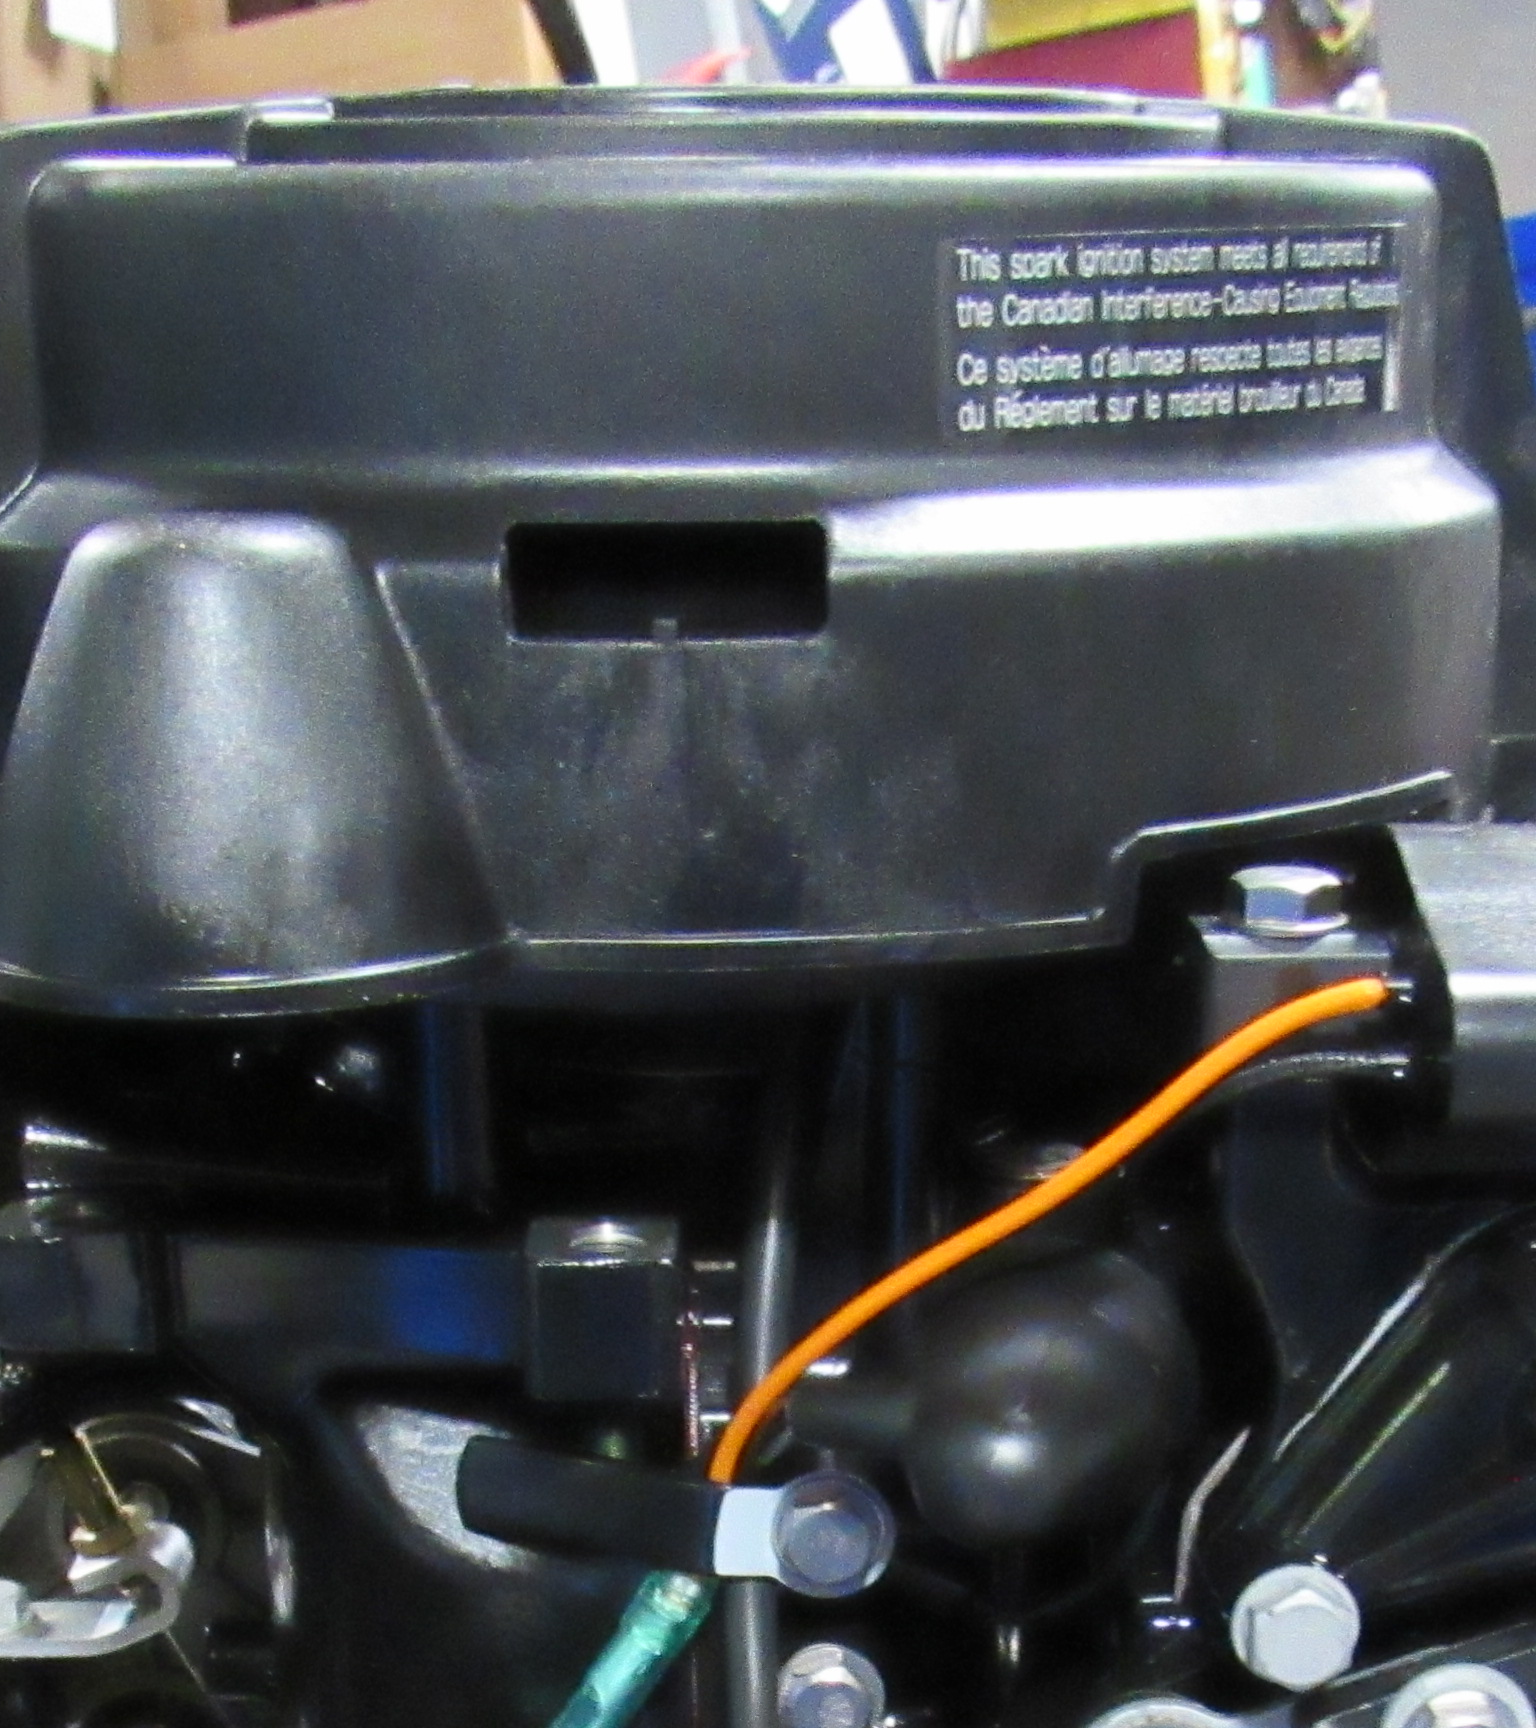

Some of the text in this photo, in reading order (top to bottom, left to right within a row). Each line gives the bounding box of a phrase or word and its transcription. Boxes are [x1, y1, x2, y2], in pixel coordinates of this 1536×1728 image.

[956, 246, 1001, 281] This
[1010, 245, 1069, 280] spark
[1076, 242, 1144, 279] ignition
[1150, 239, 1213, 276] system
[956, 295, 994, 328] the
[1001, 291, 1094, 326] Canadian
[1100, 281, 1281, 322] Interference-Causing
[956, 352, 988, 386] Ce
[995, 345, 1083, 385] système
[1090, 345, 1185, 379] d'allumage
[958, 399, 985, 431] du
[1105, 395, 1138, 423] sur
[1144, 389, 1162, 420] le
